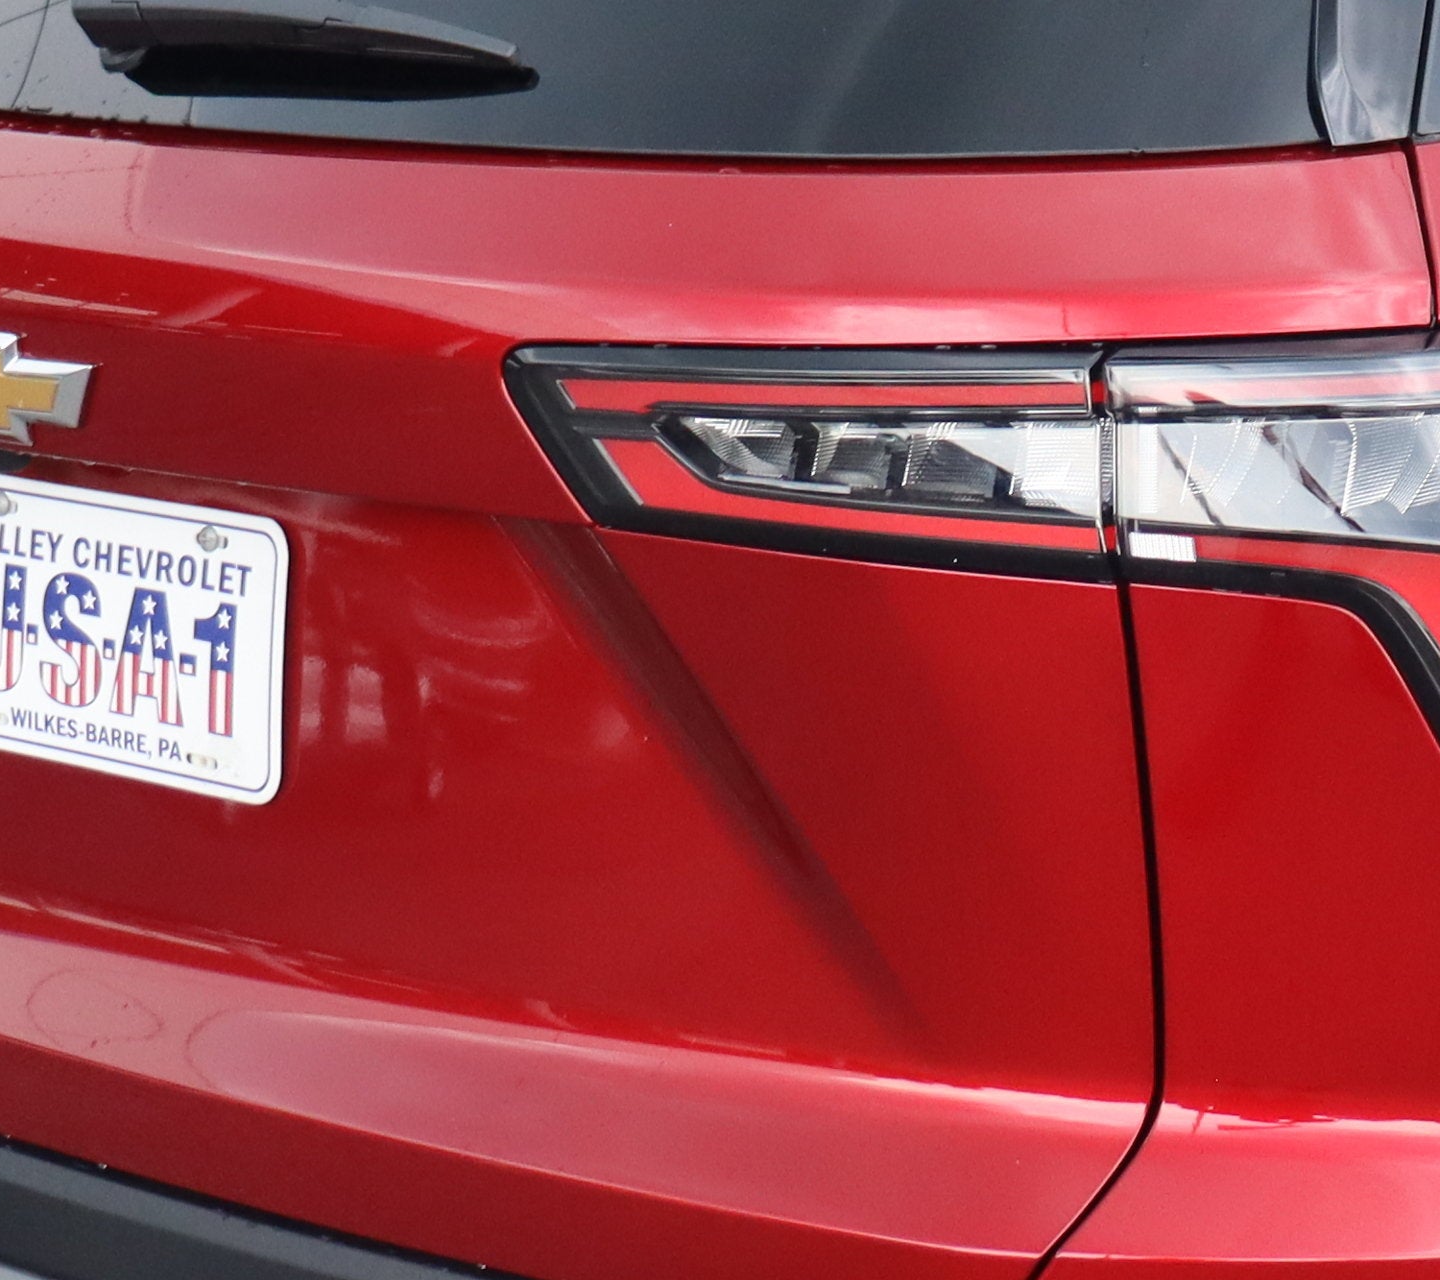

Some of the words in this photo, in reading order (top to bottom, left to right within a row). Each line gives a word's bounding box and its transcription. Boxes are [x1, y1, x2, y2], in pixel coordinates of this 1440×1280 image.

[72, 537, 252, 597] CHEVROLET
[10, 706, 153, 760] WILKES-BARRE,
[158, 738, 182, 762] PA
